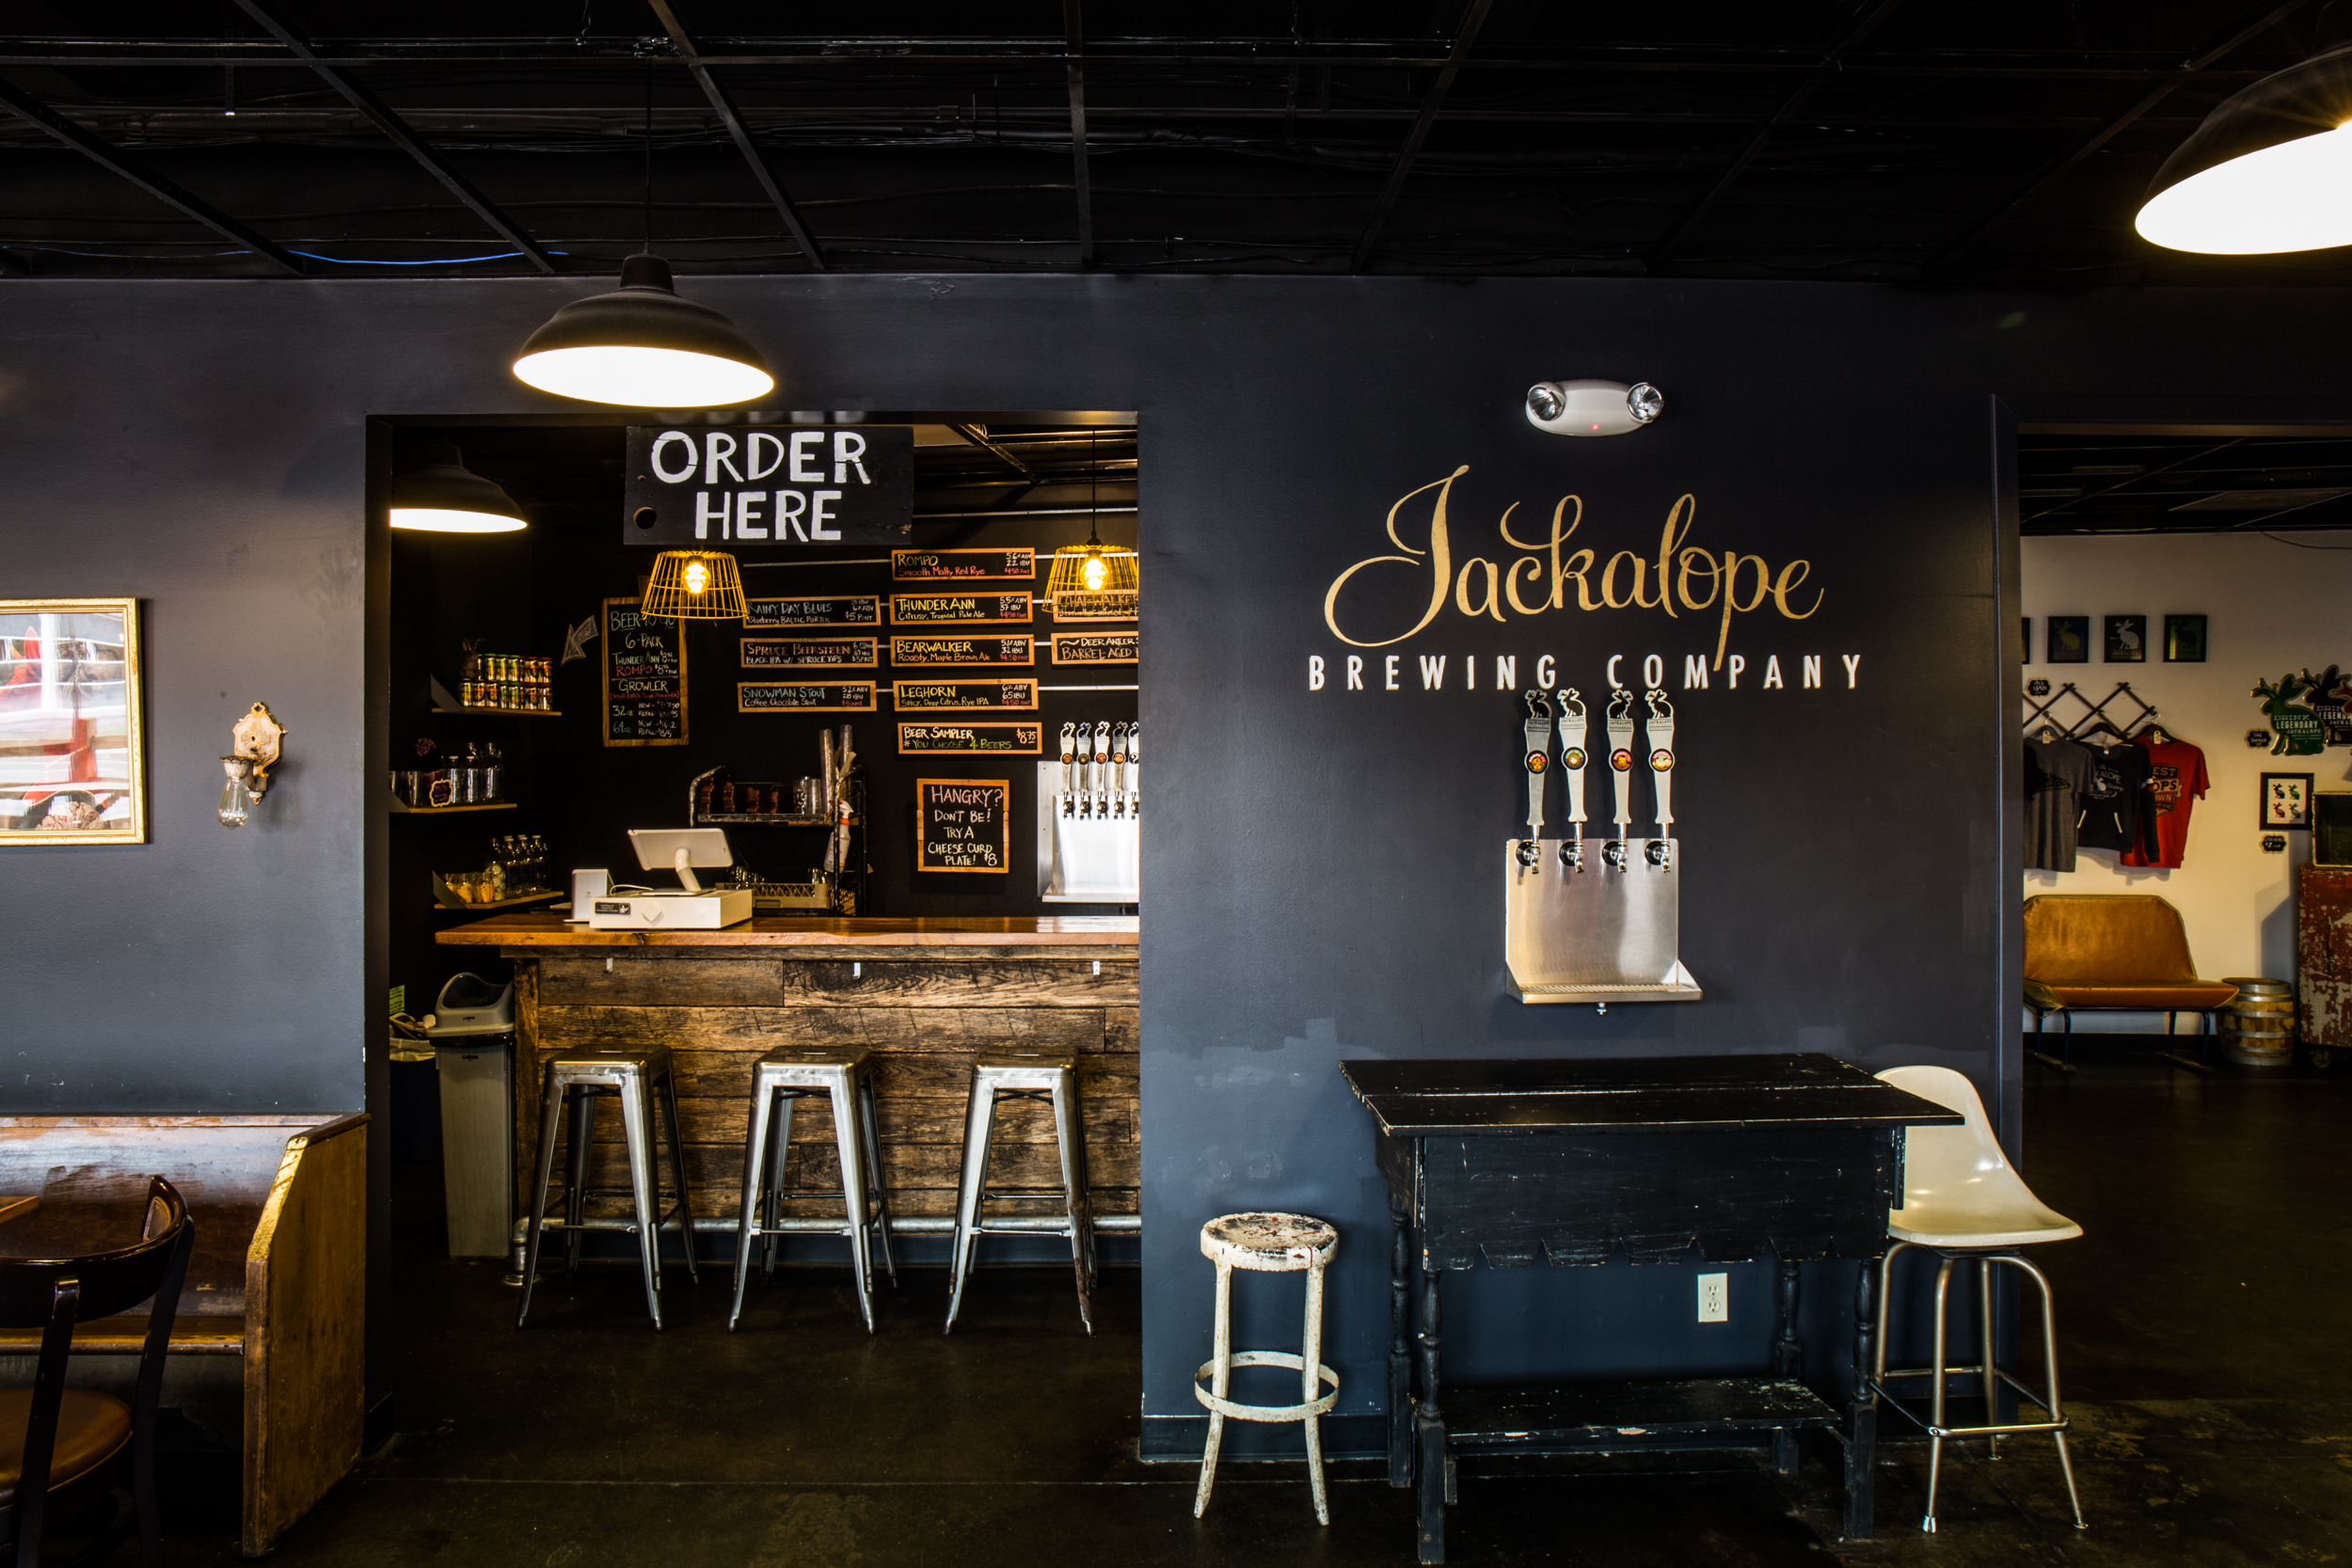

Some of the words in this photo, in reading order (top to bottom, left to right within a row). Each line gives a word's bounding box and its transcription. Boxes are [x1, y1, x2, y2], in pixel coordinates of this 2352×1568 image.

[651, 431, 870, 484] ORDER
[695, 489, 842, 542] HERE
[898, 554, 938, 566] ROMPO
[932, 566, 953, 576] Malty
[955, 566, 968, 576] Red
[970, 565, 985, 577] Rye
[1324, 465, 1824, 672] Jackalope
[748, 602, 780, 615] RAINY
[781, 602, 800, 615] DAY
[803, 602, 832, 614] BLUES
[896, 597, 948, 611] THUNDER
[950, 597, 976, 610] ANN
[999, 603, 1009, 611] 37
[748, 616, 779, 626] Blueberry
[846, 610, 856, 621] $5
[930, 610, 956, 620] Tropical
[626, 633, 663, 649] 6-PACK
[897, 641, 973, 653] BEARWALKER
[1081, 638, 1105, 646] DEER
[1105, 637, 1135, 646] ANTLER
[747, 643, 789, 656] SPRUCE
[612, 652, 644, 665] THUNDER
[645, 651, 660, 663] ANN
[746, 656, 768, 664] BLACK
[797, 656, 825, 664] SPRUCE
[898, 653, 930, 662] Roasty,
[930, 653, 952, 661] Maple
[954, 653, 977, 661] Brown
[978, 652, 991, 660] Ale
[616, 665, 653, 676] ROMPO
[1309, 655, 1557, 691] BREWING
[1606, 654, 1861, 690] COMPANY
[619, 679, 668, 693] GROWLER
[900, 686, 956, 698] LEGHORN
[743, 687, 796, 698] SNOWMAN
[901, 699, 922, 707] Spicy,
[961, 697, 975, 706] Rye
[977, 697, 989, 705] IPA
[2276, 721, 2319, 729] LEGENDARY
[904, 727, 929, 739] BEER
[930, 727, 975, 740] SAMPLER
[913, 739, 929, 749] YOU
[932, 739, 964, 749] CHOOSE
[969, 739, 977, 750] 4
[980, 739, 1012, 749] BEERS
[2152, 767, 2176, 776] EST
[2153, 780, 2178, 791] OPS
[931, 785, 1004, 808] HANGRY?
[2155, 793, 2171, 801] OWN
[934, 809, 965, 823] DON'T
[970, 808, 992, 823] BE!
[943, 827, 963, 838] TRY
[964, 826, 974, 839] A
[928, 842, 964, 855] CHEESE
[967, 843, 993, 853] CURD
[945, 855, 977, 865] PLATE!
[983, 852, 997, 866] $8
